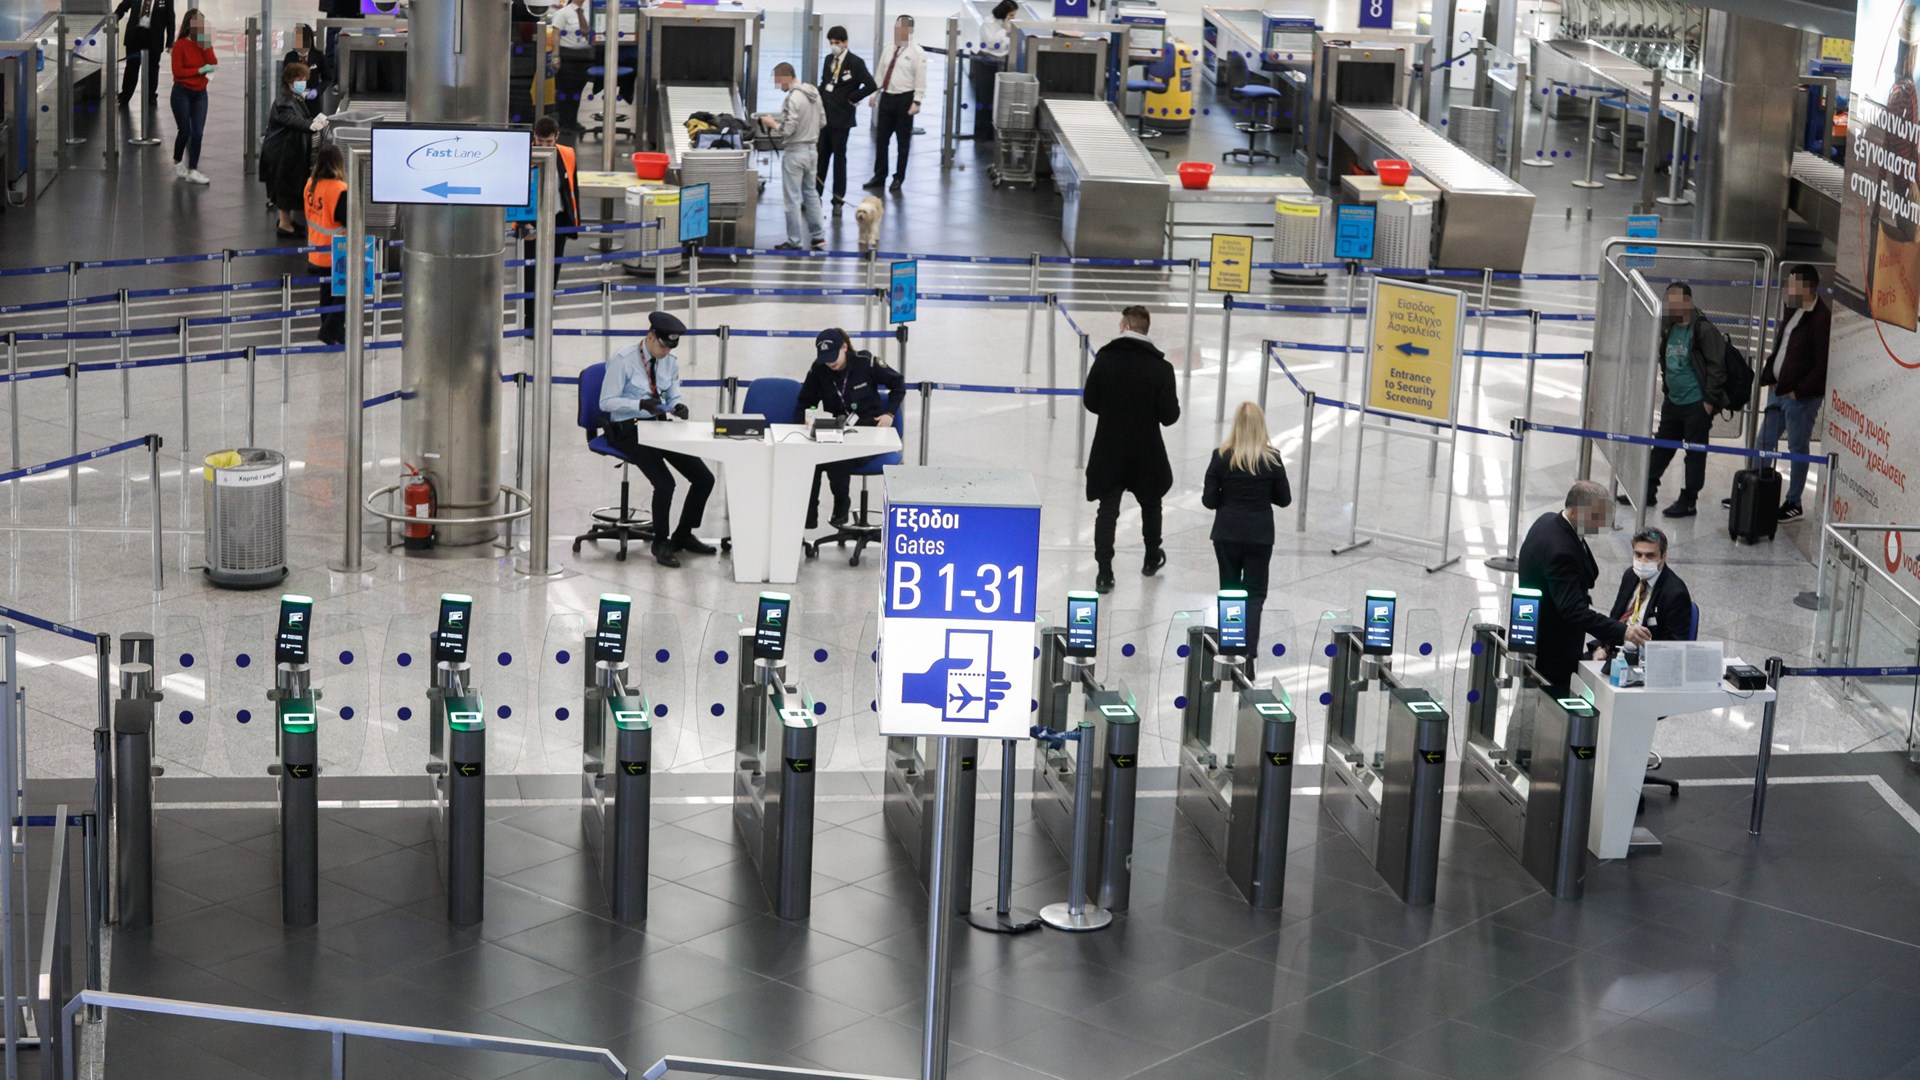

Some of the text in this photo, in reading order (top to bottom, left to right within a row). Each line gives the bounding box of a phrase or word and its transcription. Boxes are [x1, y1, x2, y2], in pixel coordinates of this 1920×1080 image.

[426, 148, 482, 159] Fast Lane
[1854, 128, 1917, 182] ξέγνοιαστα
[1850, 172, 1879, 207] στην
[307, 193, 323, 211] GS
[1878, 287, 1897, 308] Paris
[1388, 311, 1404, 321] για
[1390, 367, 1432, 384] Entrance
[1385, 379, 1436, 398] to Security
[1386, 390, 1433, 410] Screening
[1832, 389, 1890, 451] Roaming χωρίς
[1828, 421, 1906, 493] επιπλέον χρεώσεις
[890, 507, 960, 532] Έξοδοι
[895, 533, 945, 556] Gates
[892, 561, 1024, 615] B 1-31
